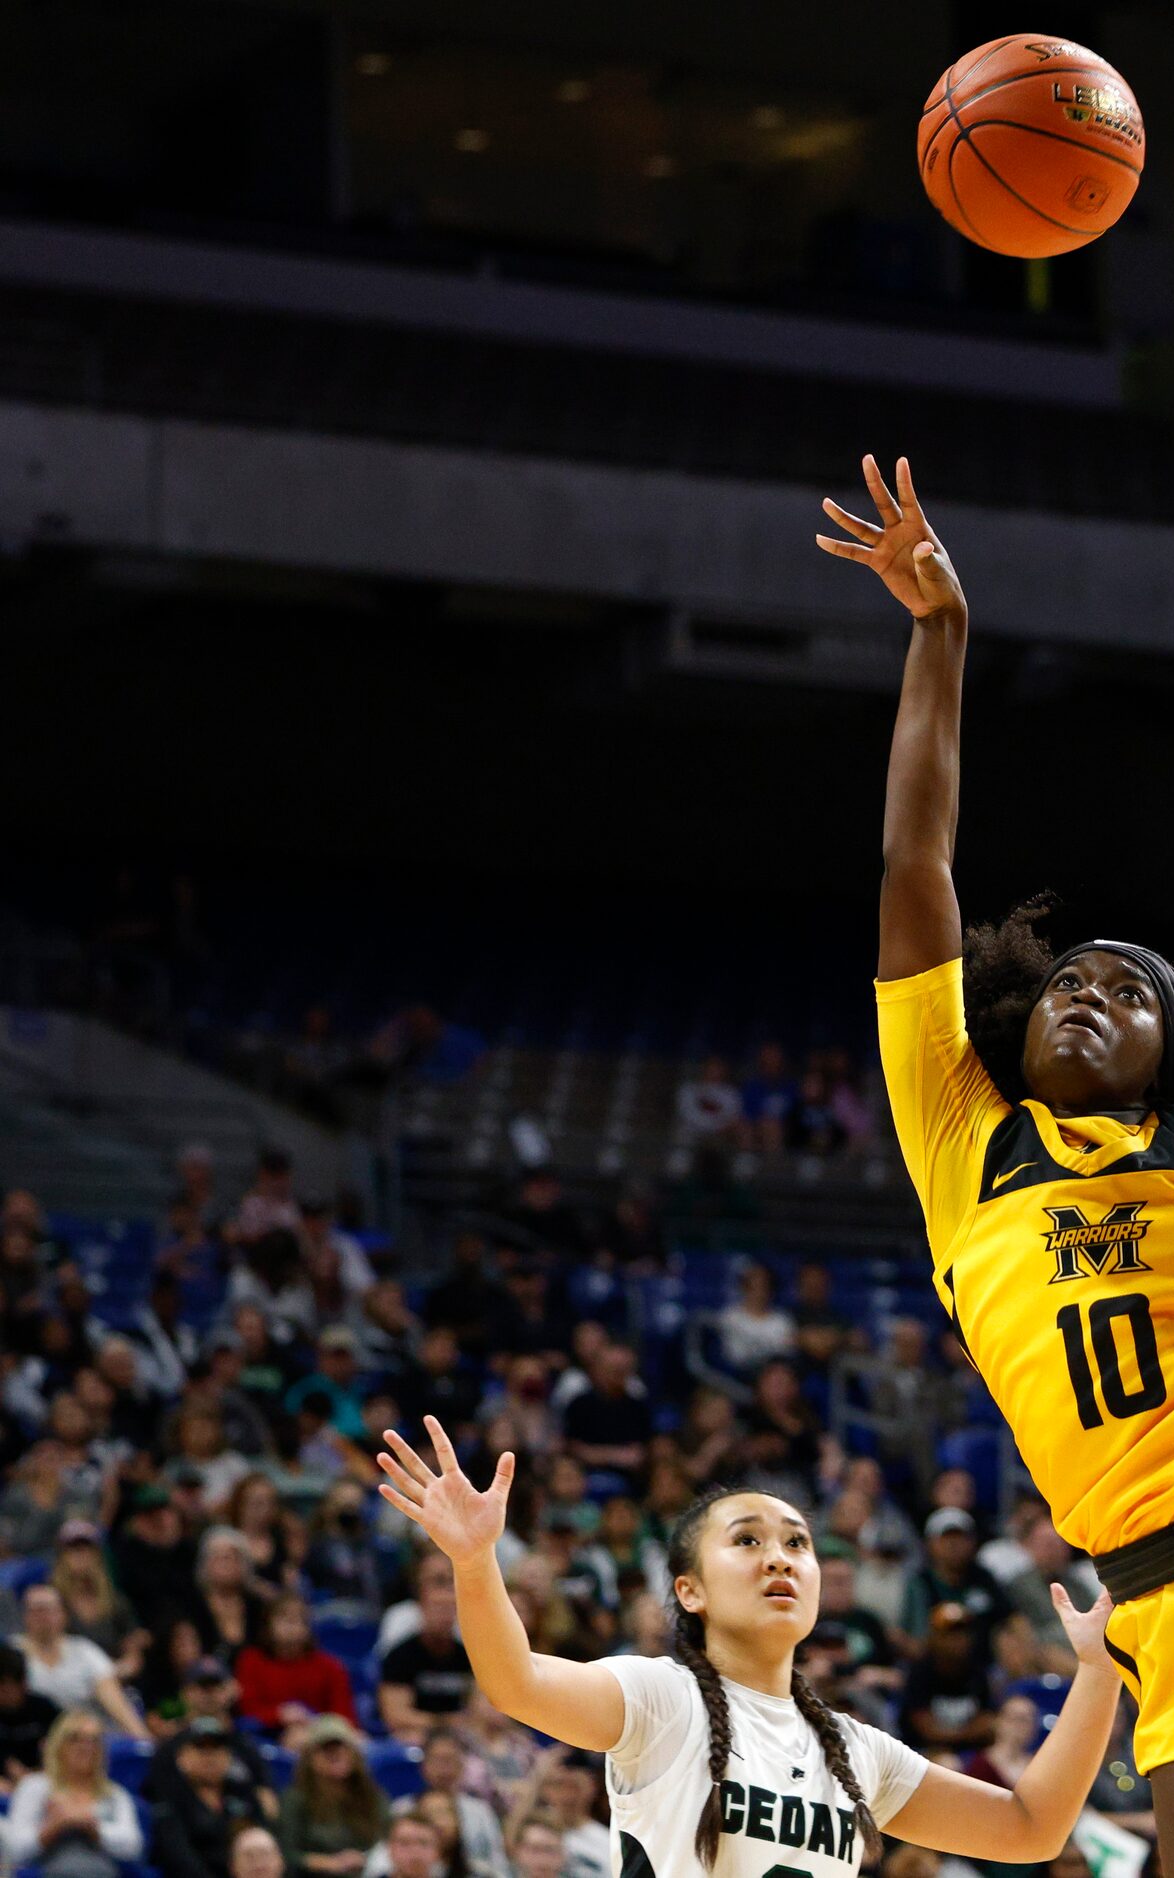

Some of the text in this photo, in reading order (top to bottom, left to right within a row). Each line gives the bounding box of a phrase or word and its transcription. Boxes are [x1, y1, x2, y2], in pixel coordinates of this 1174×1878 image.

[1042, 1201, 1153, 1285] M
[1044, 1221, 1150, 1252] WARRIORS
[1057, 1293, 1167, 1431] 10
[720, 1779, 855, 1865] CEDAR
